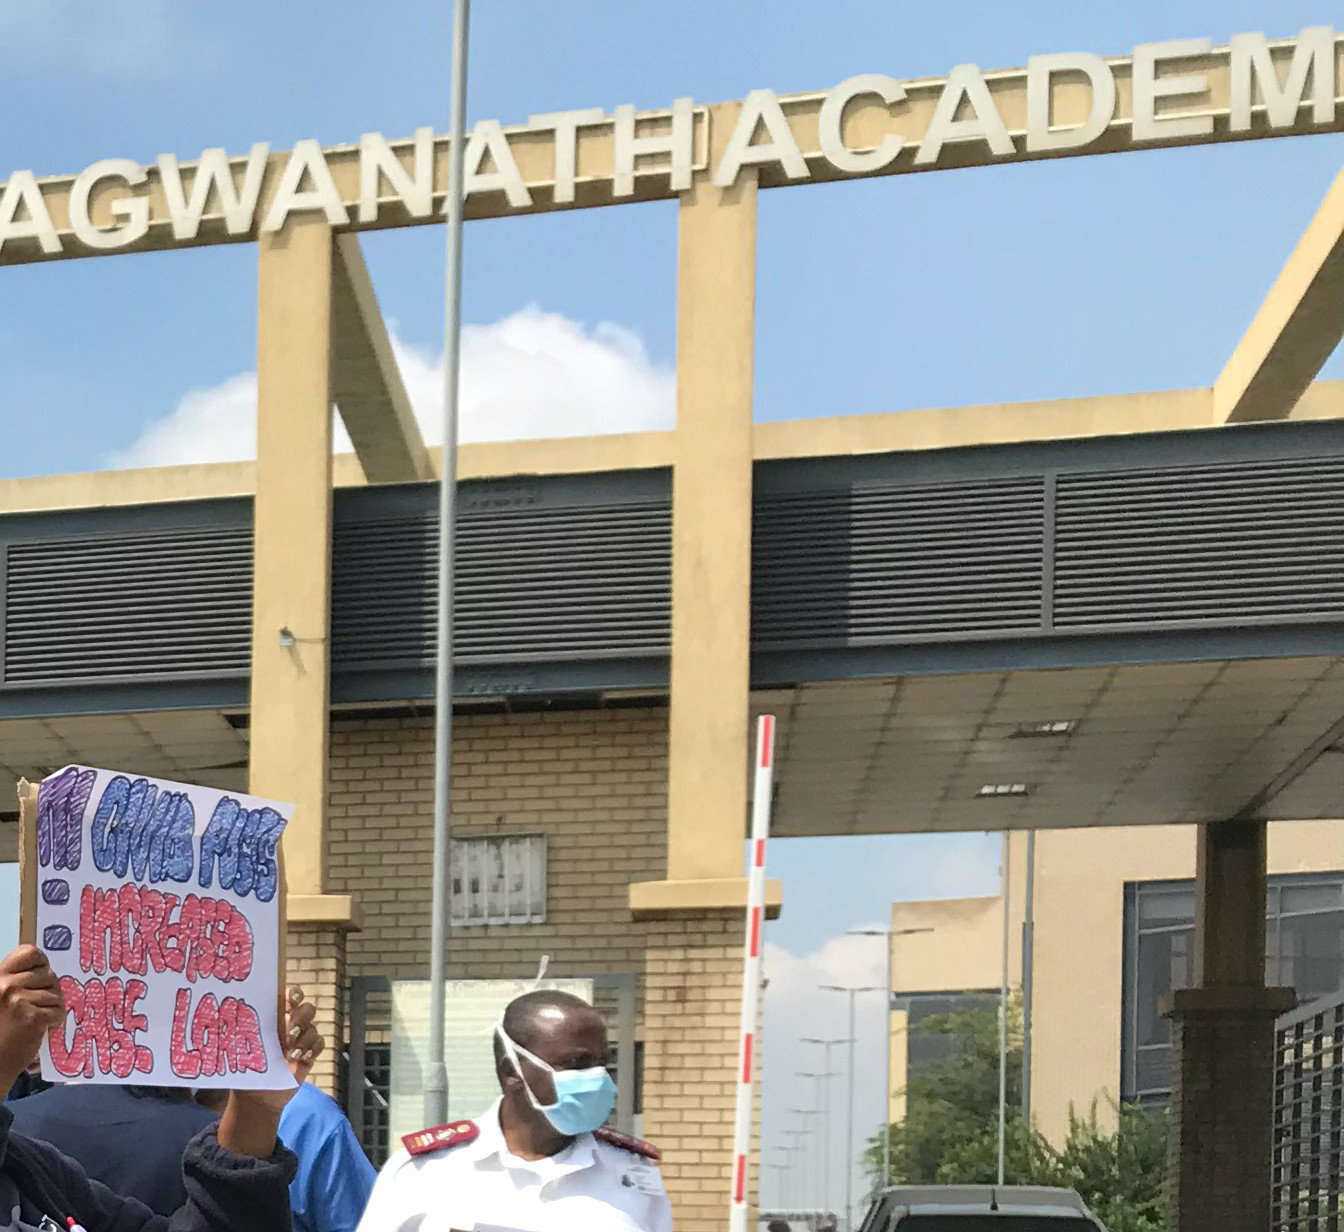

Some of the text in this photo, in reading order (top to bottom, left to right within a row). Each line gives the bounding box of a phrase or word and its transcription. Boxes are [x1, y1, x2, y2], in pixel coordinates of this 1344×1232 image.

[713, 25, 1335, 187] ACADEM
[79, 882, 255, 984] INCREASED
[48, 974, 269, 1079] CASE LOAD
